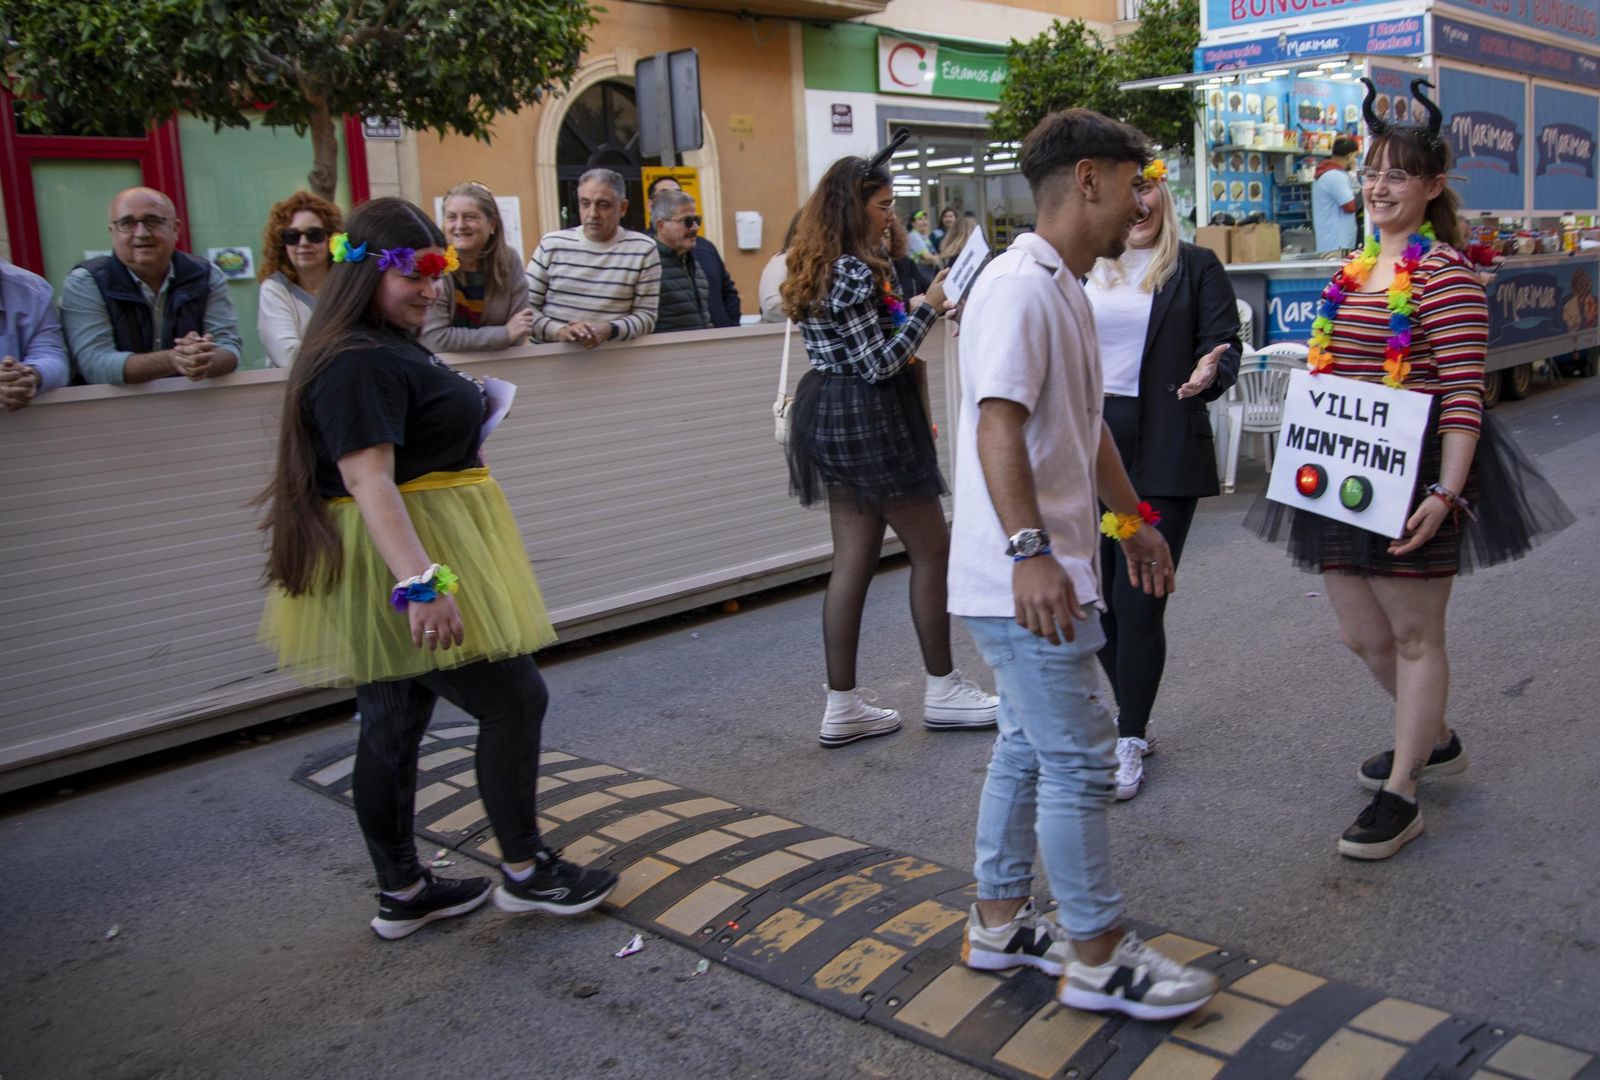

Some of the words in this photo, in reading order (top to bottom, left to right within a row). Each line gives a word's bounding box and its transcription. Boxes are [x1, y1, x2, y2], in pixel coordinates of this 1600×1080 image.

[942, 60, 989, 83] Estamos
[1309, 390, 1389, 428] VILLA
[1286, 423, 1407, 477] MONTAÑA
